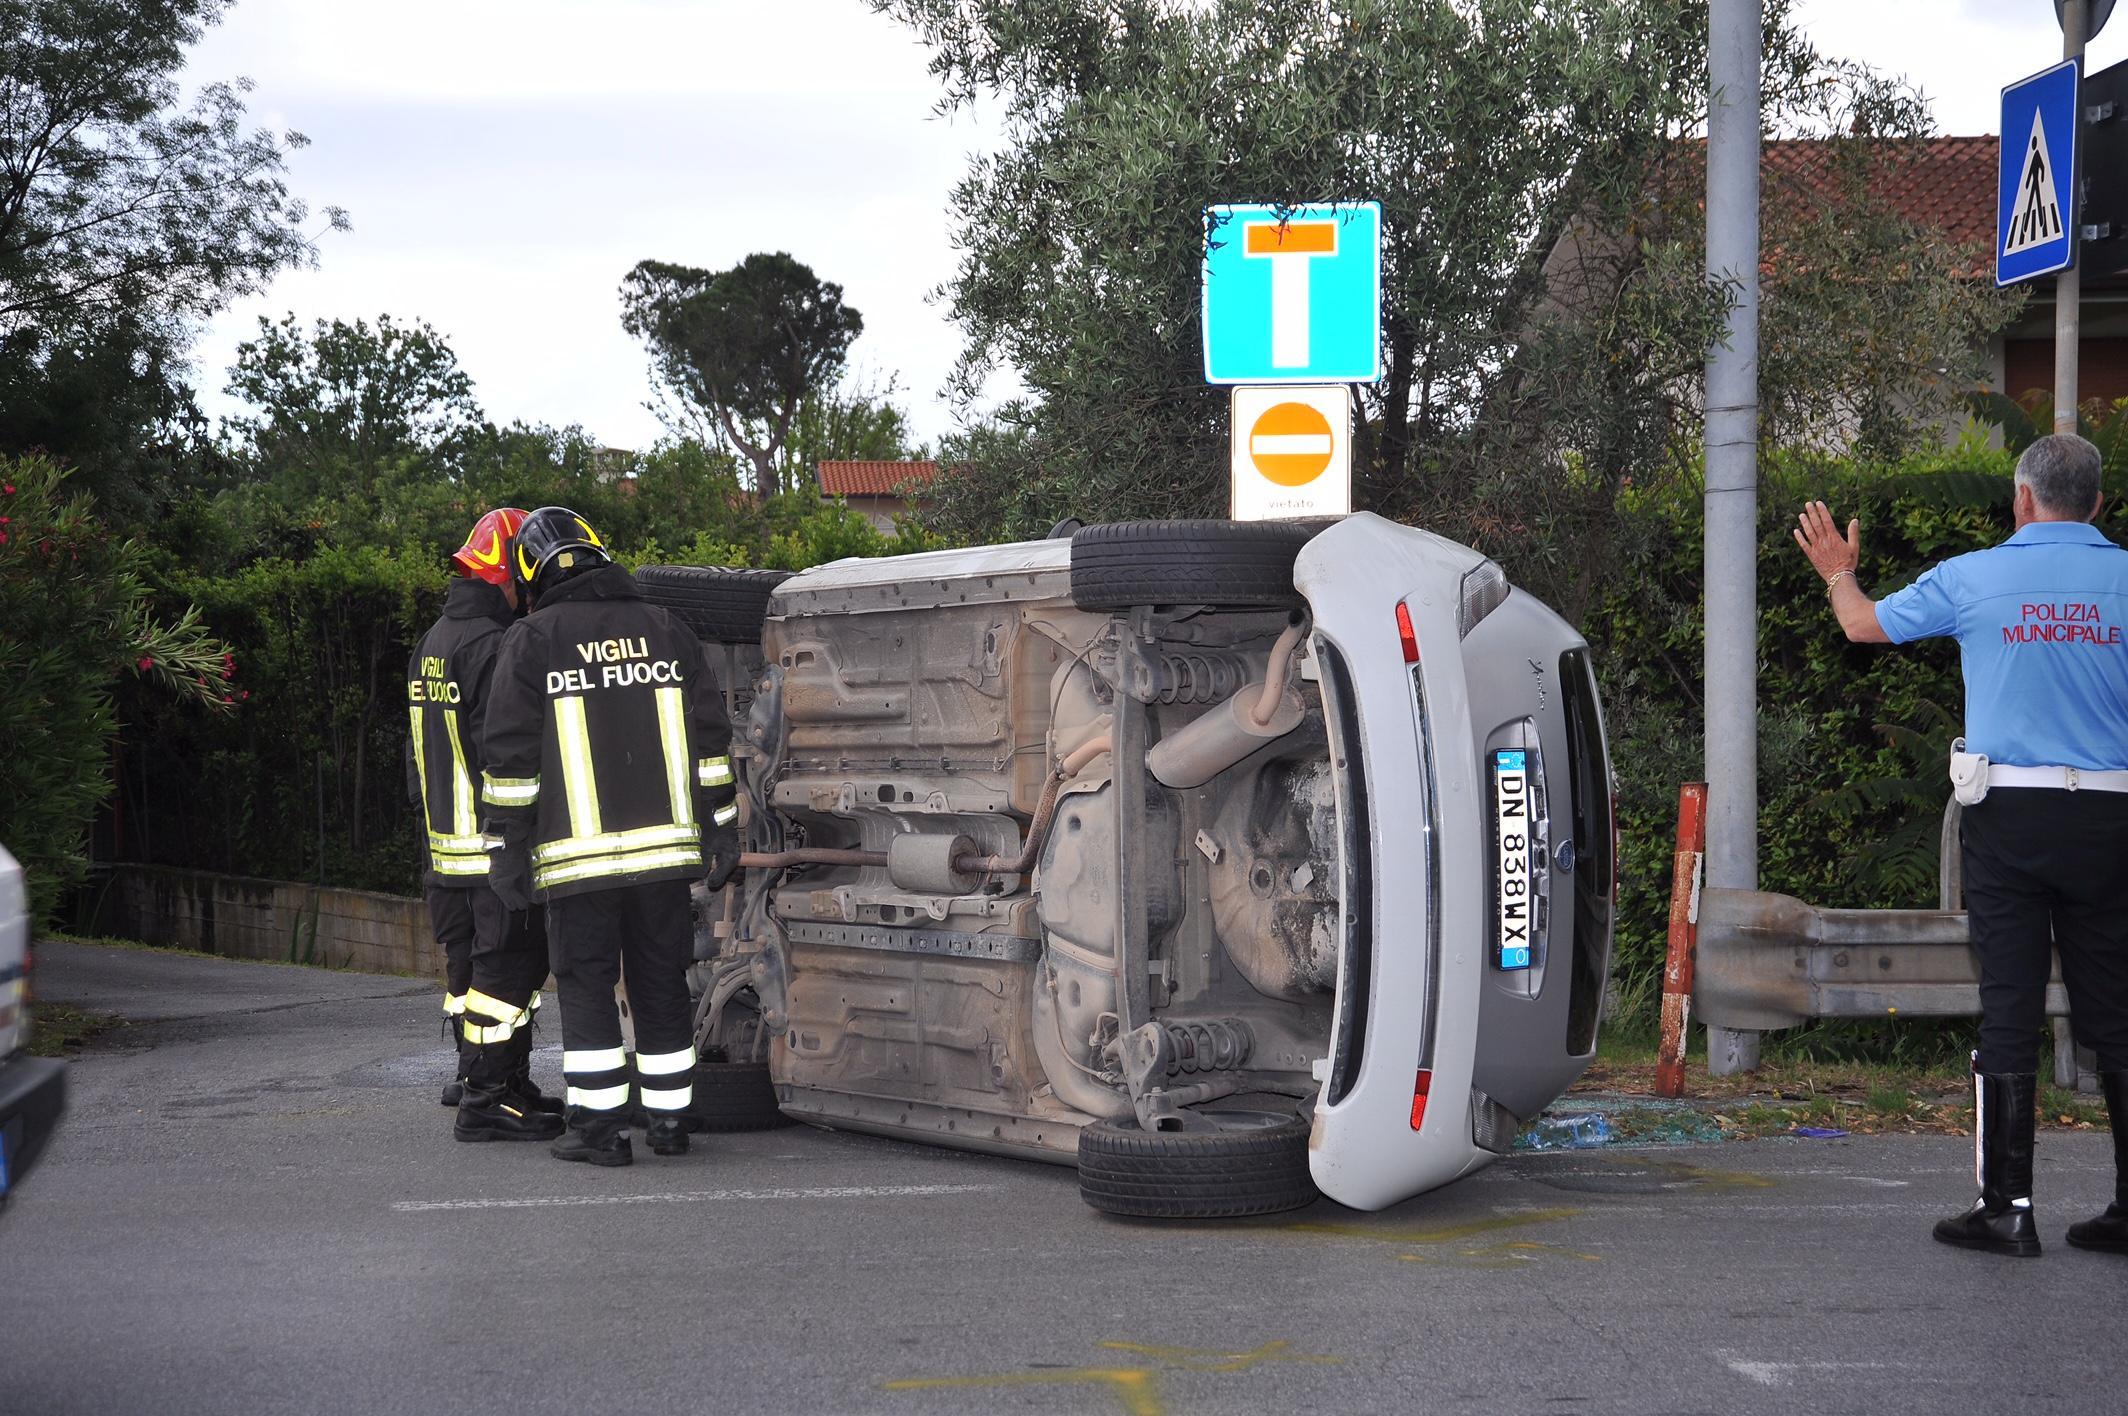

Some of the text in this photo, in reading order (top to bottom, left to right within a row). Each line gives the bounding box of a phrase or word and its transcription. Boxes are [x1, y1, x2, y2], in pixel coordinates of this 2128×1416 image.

[1268, 499, 1314, 509] vietato
[2021, 603, 2100, 622] POLIZIA
[2003, 624, 2121, 645] MUNICIPALE
[577, 637, 649, 664] VIGILI
[547, 668, 596, 694] DEL
[1501, 776, 1527, 942] DN 838WX
